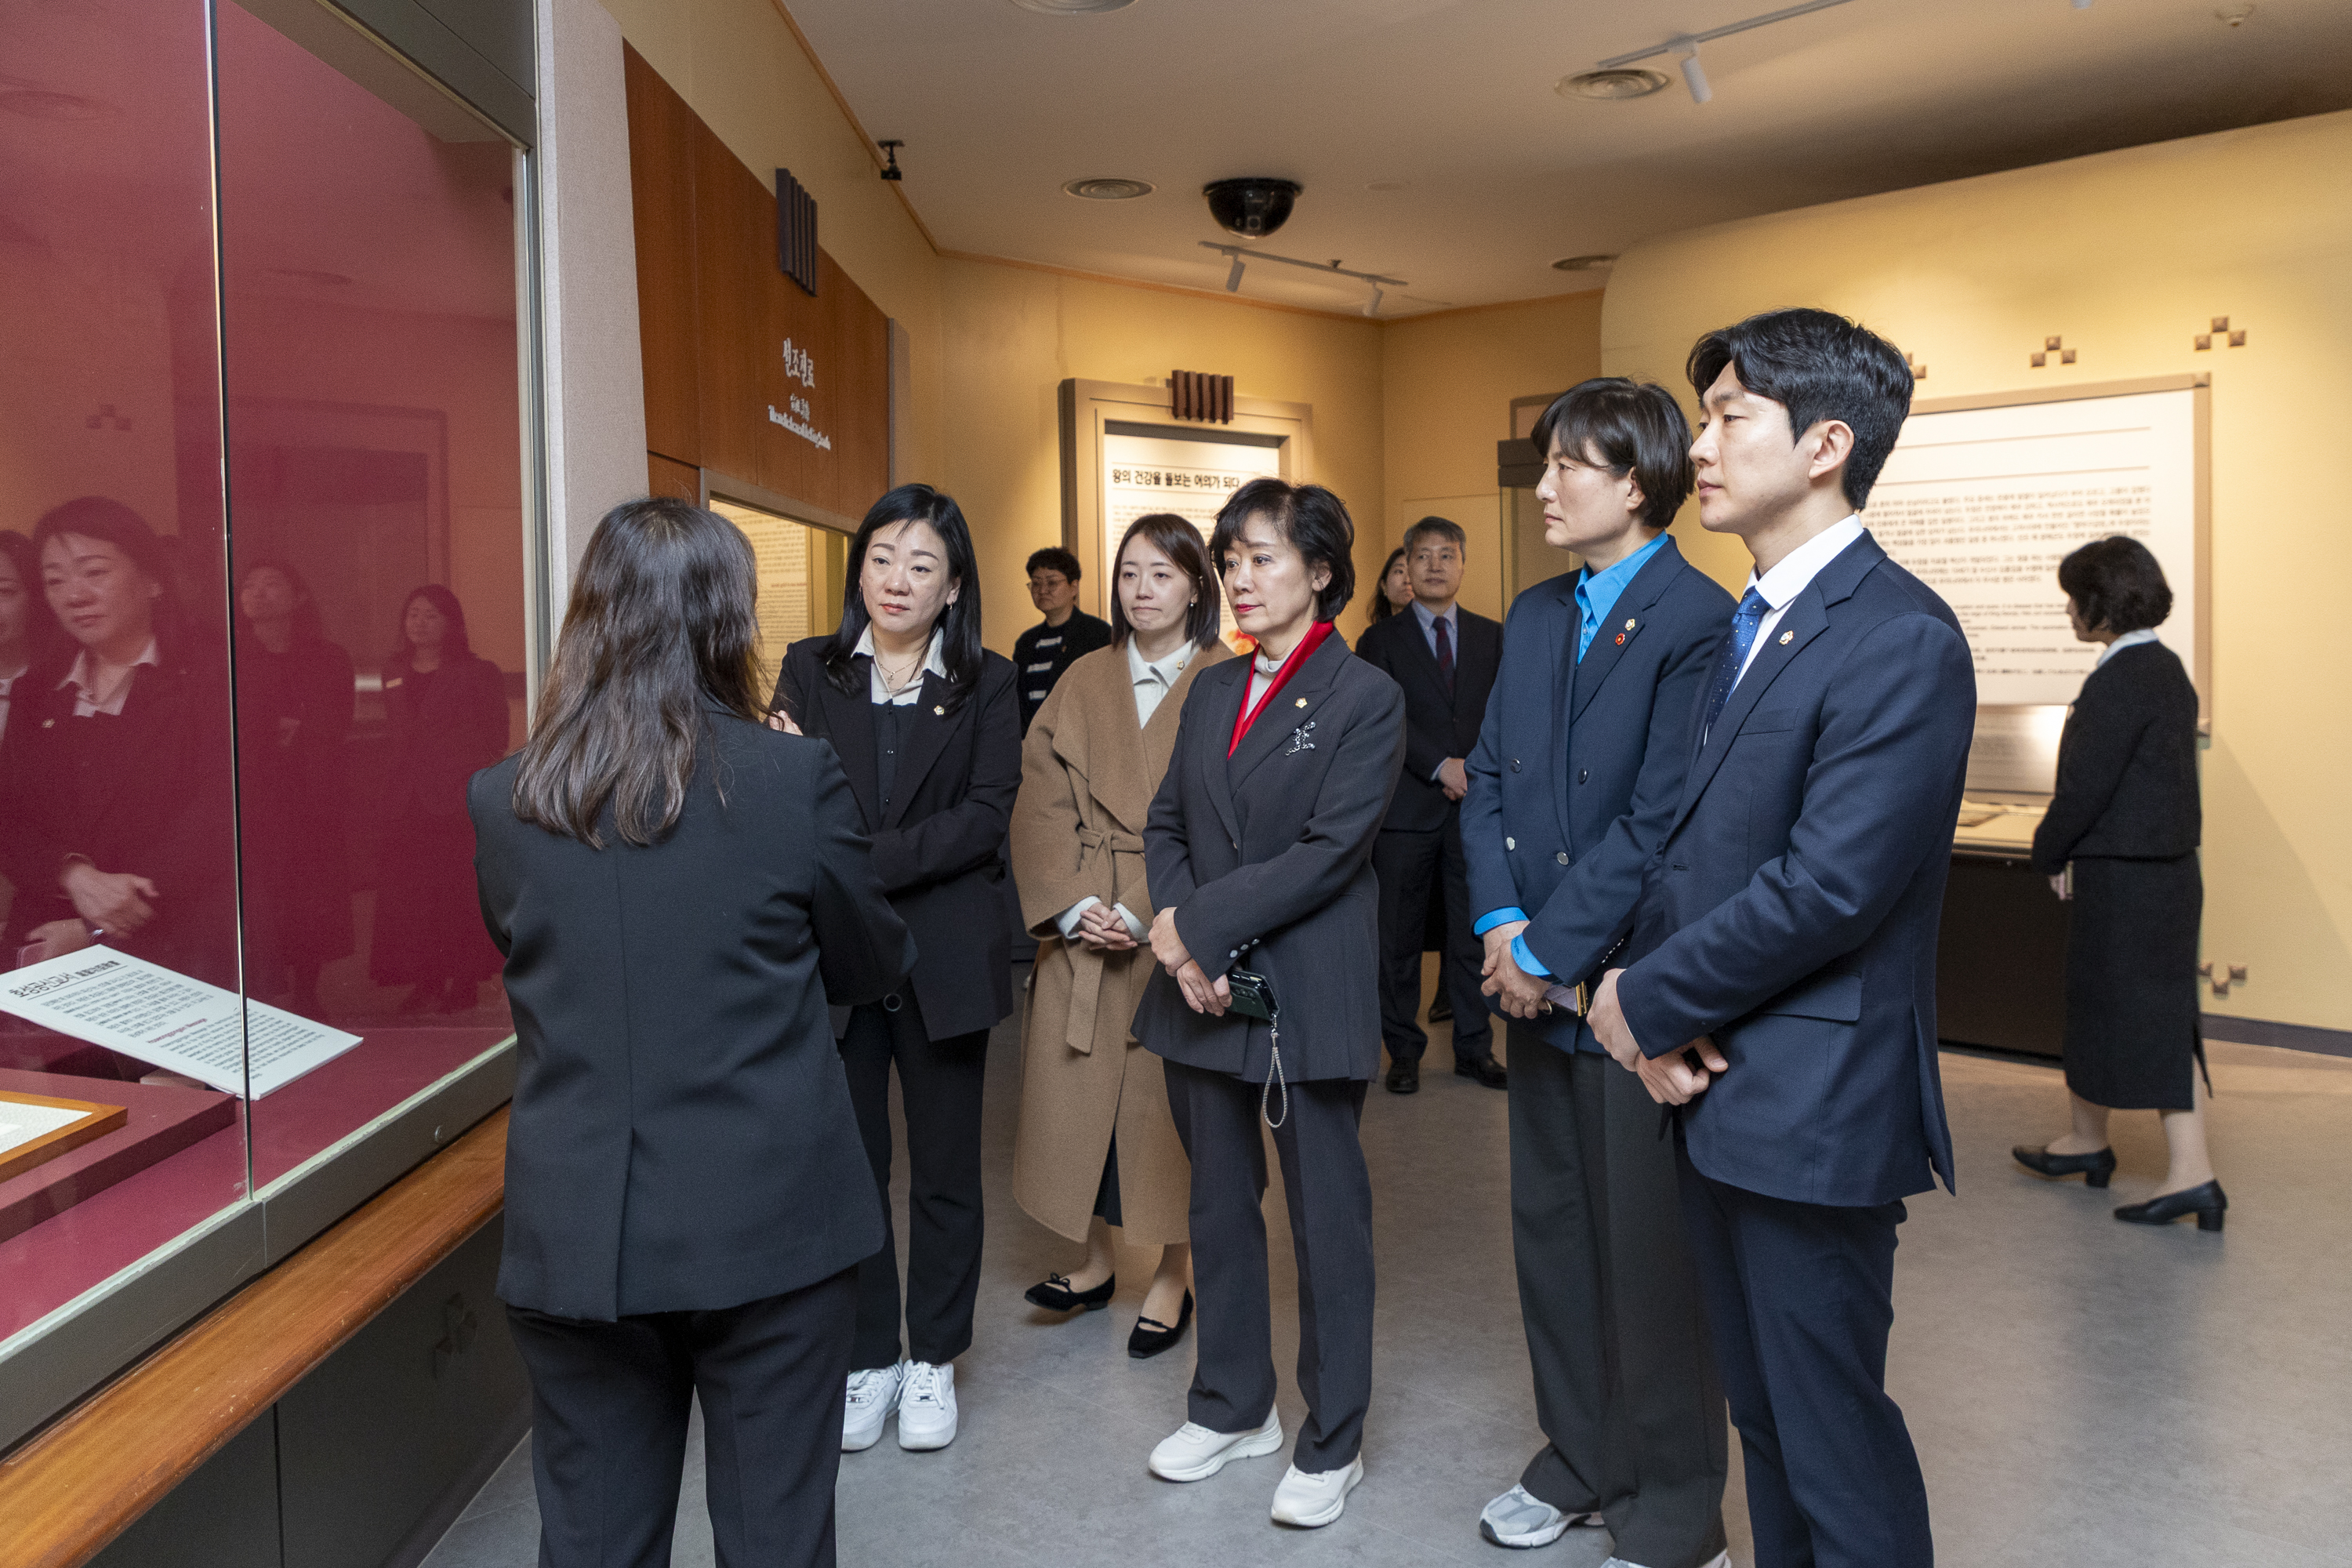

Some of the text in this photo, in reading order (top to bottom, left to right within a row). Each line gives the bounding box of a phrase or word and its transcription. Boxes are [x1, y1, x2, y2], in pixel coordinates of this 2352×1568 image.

[1112, 469, 1240, 488] 왕의 건강을 돌보는 어의가 되다
